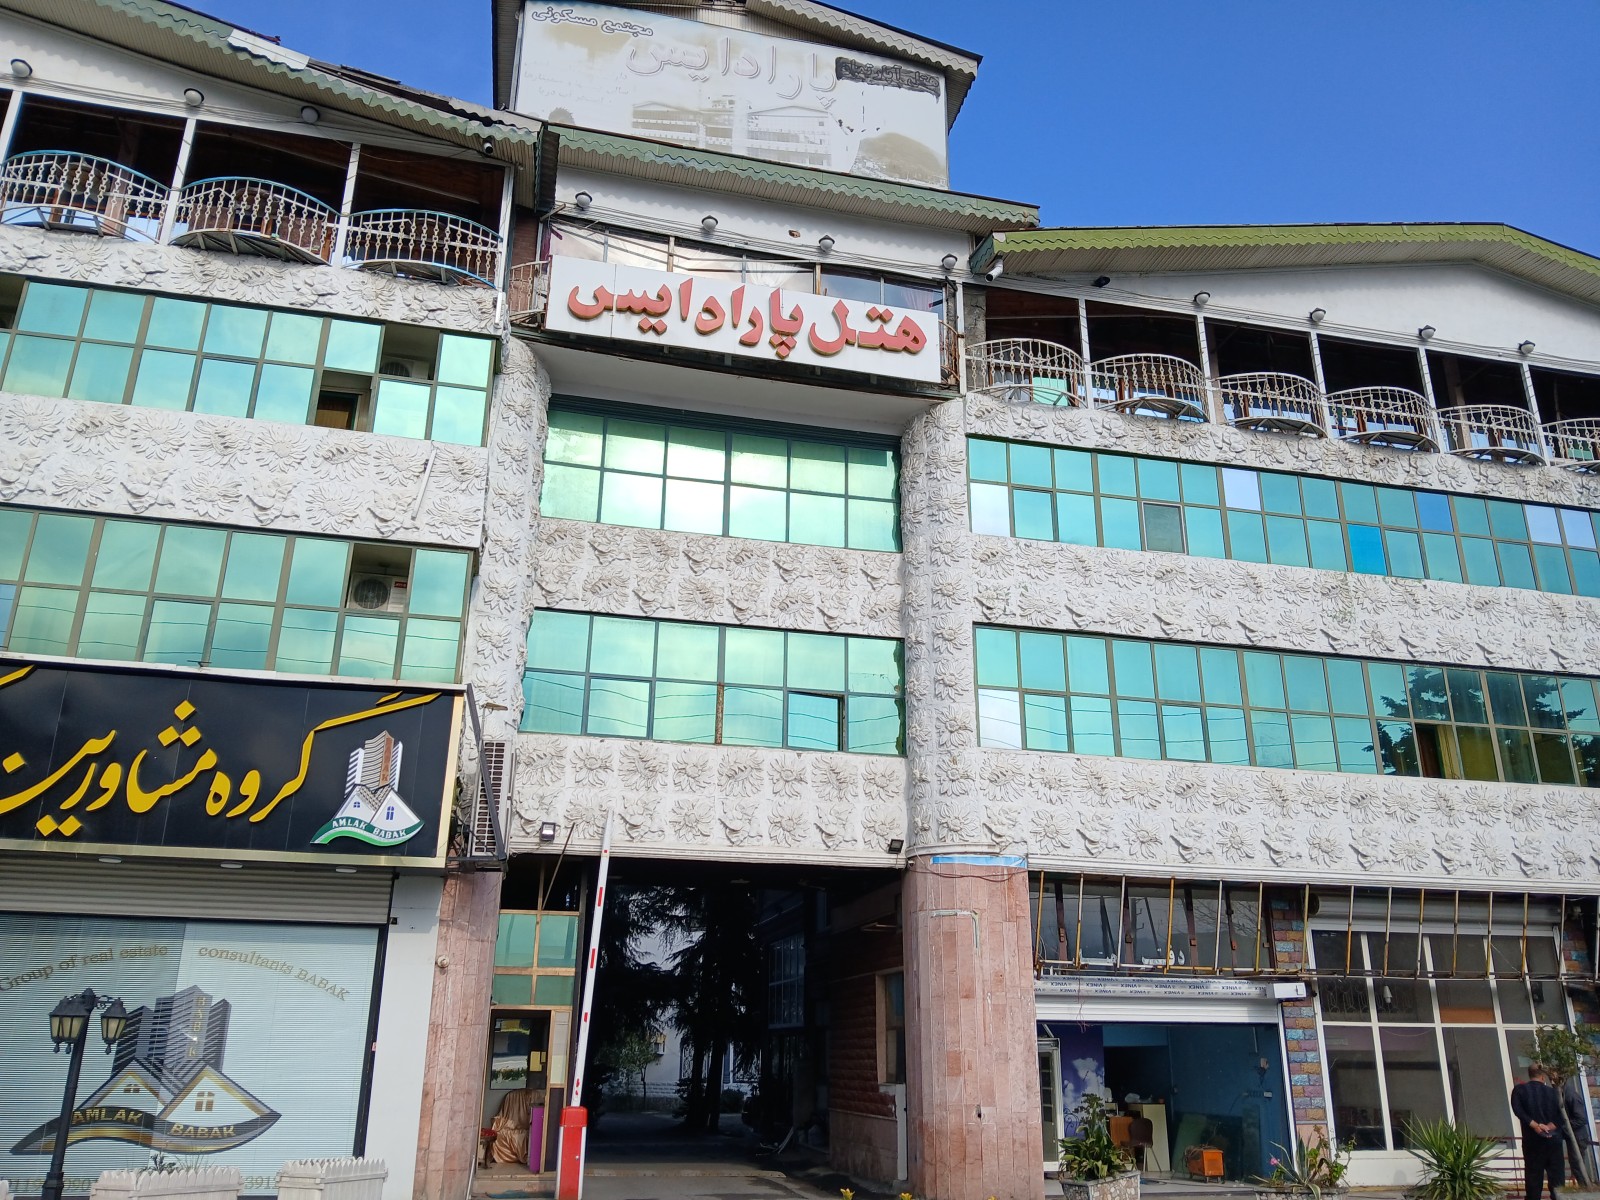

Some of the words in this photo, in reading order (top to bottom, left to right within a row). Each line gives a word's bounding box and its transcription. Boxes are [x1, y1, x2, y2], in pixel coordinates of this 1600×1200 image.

[532, 7, 597, 27] مسکونی
[601, 20, 653, 37] مجتمع
[626, 37, 837, 108] پارادایس
[567, 277, 804, 359] پارادایس
[809, 299, 928, 356] هتل
[206, 690, 442, 823] گروه
[332, 818, 368, 831] AMLAK
[372, 826, 407, 840] BABAK
[0, 964, 54, 992] Group
[59, 955, 79, 971] of
[83, 948, 114, 966] real
[119, 945, 169, 960] estate
[198, 946, 295, 976] consultants
[294, 967, 351, 1002] BABAK
[72, 1108, 143, 1125] AMLAK
[169, 1122, 237, 1140] BABAK
